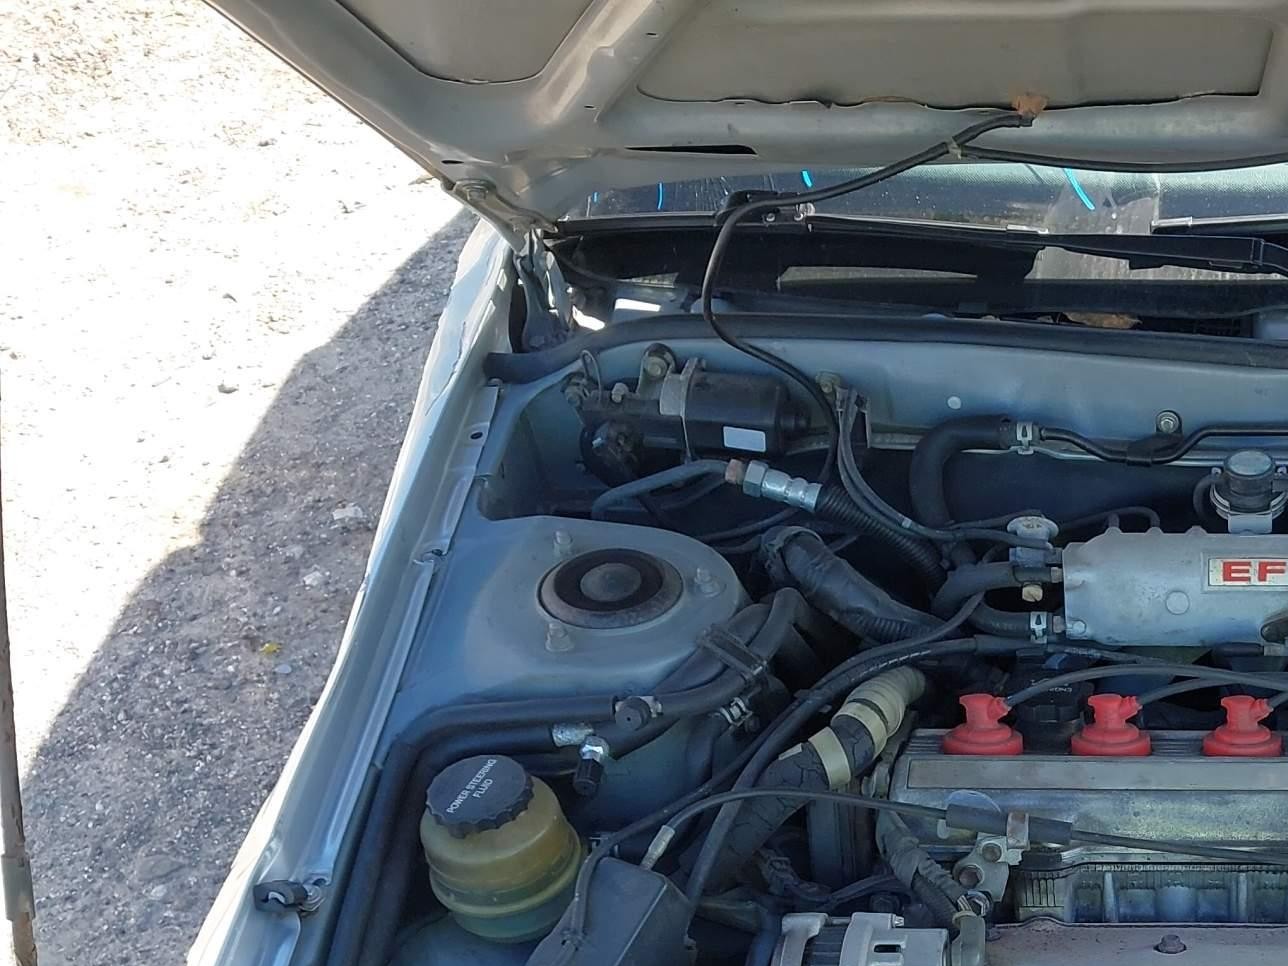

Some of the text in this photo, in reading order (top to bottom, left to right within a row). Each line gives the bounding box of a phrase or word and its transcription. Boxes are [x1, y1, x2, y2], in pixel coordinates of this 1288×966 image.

[446, 759, 497, 813] POWER STEERING
[472, 778, 493, 798] FLUID
